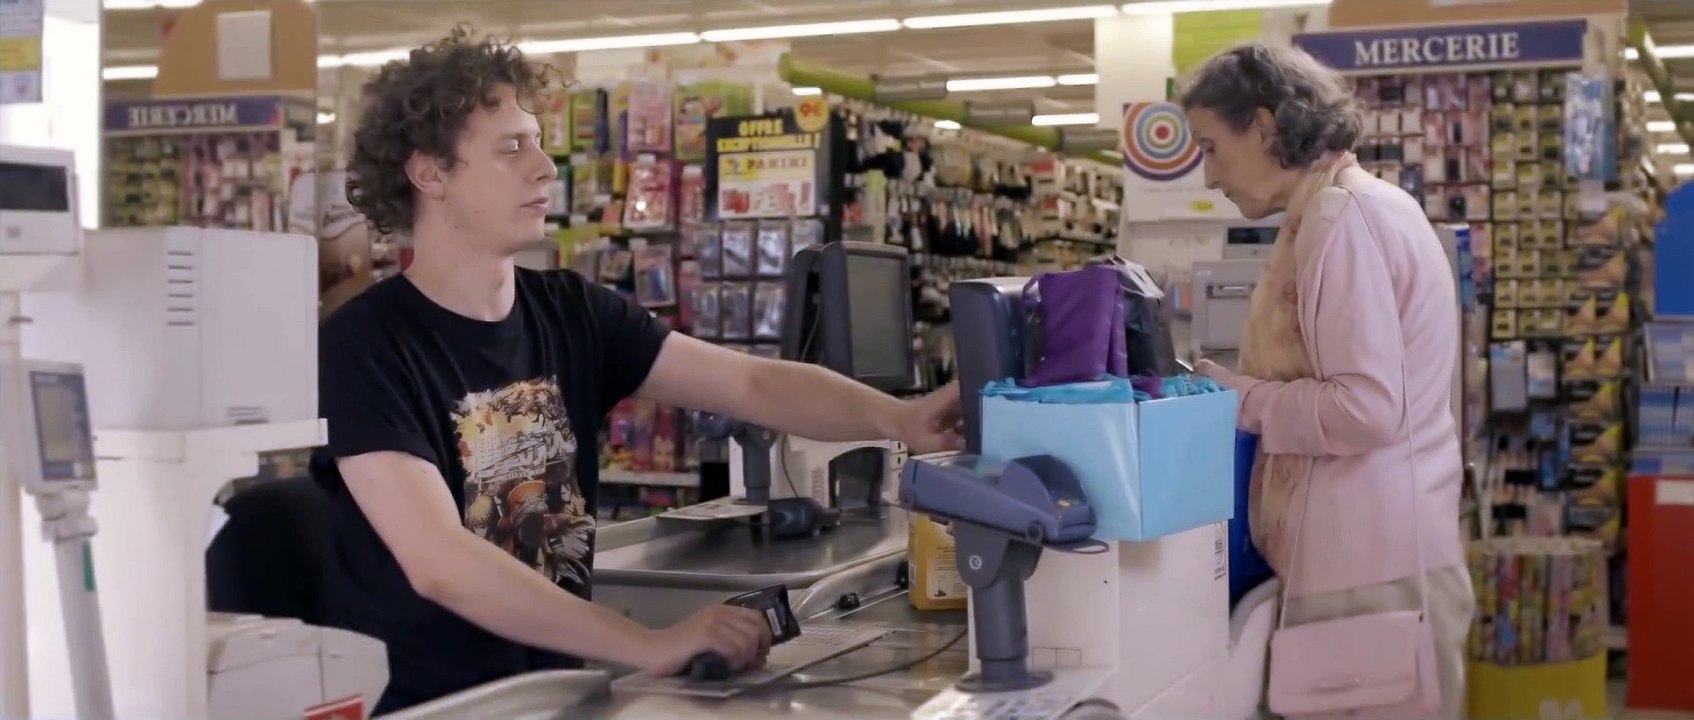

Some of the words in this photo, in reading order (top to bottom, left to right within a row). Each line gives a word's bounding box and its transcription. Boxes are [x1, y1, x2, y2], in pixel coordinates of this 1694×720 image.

[1354, 32, 1519, 66] MERCERIE
[738, 119, 784, 137] OFFRE
[746, 157, 808, 170] PANINI
